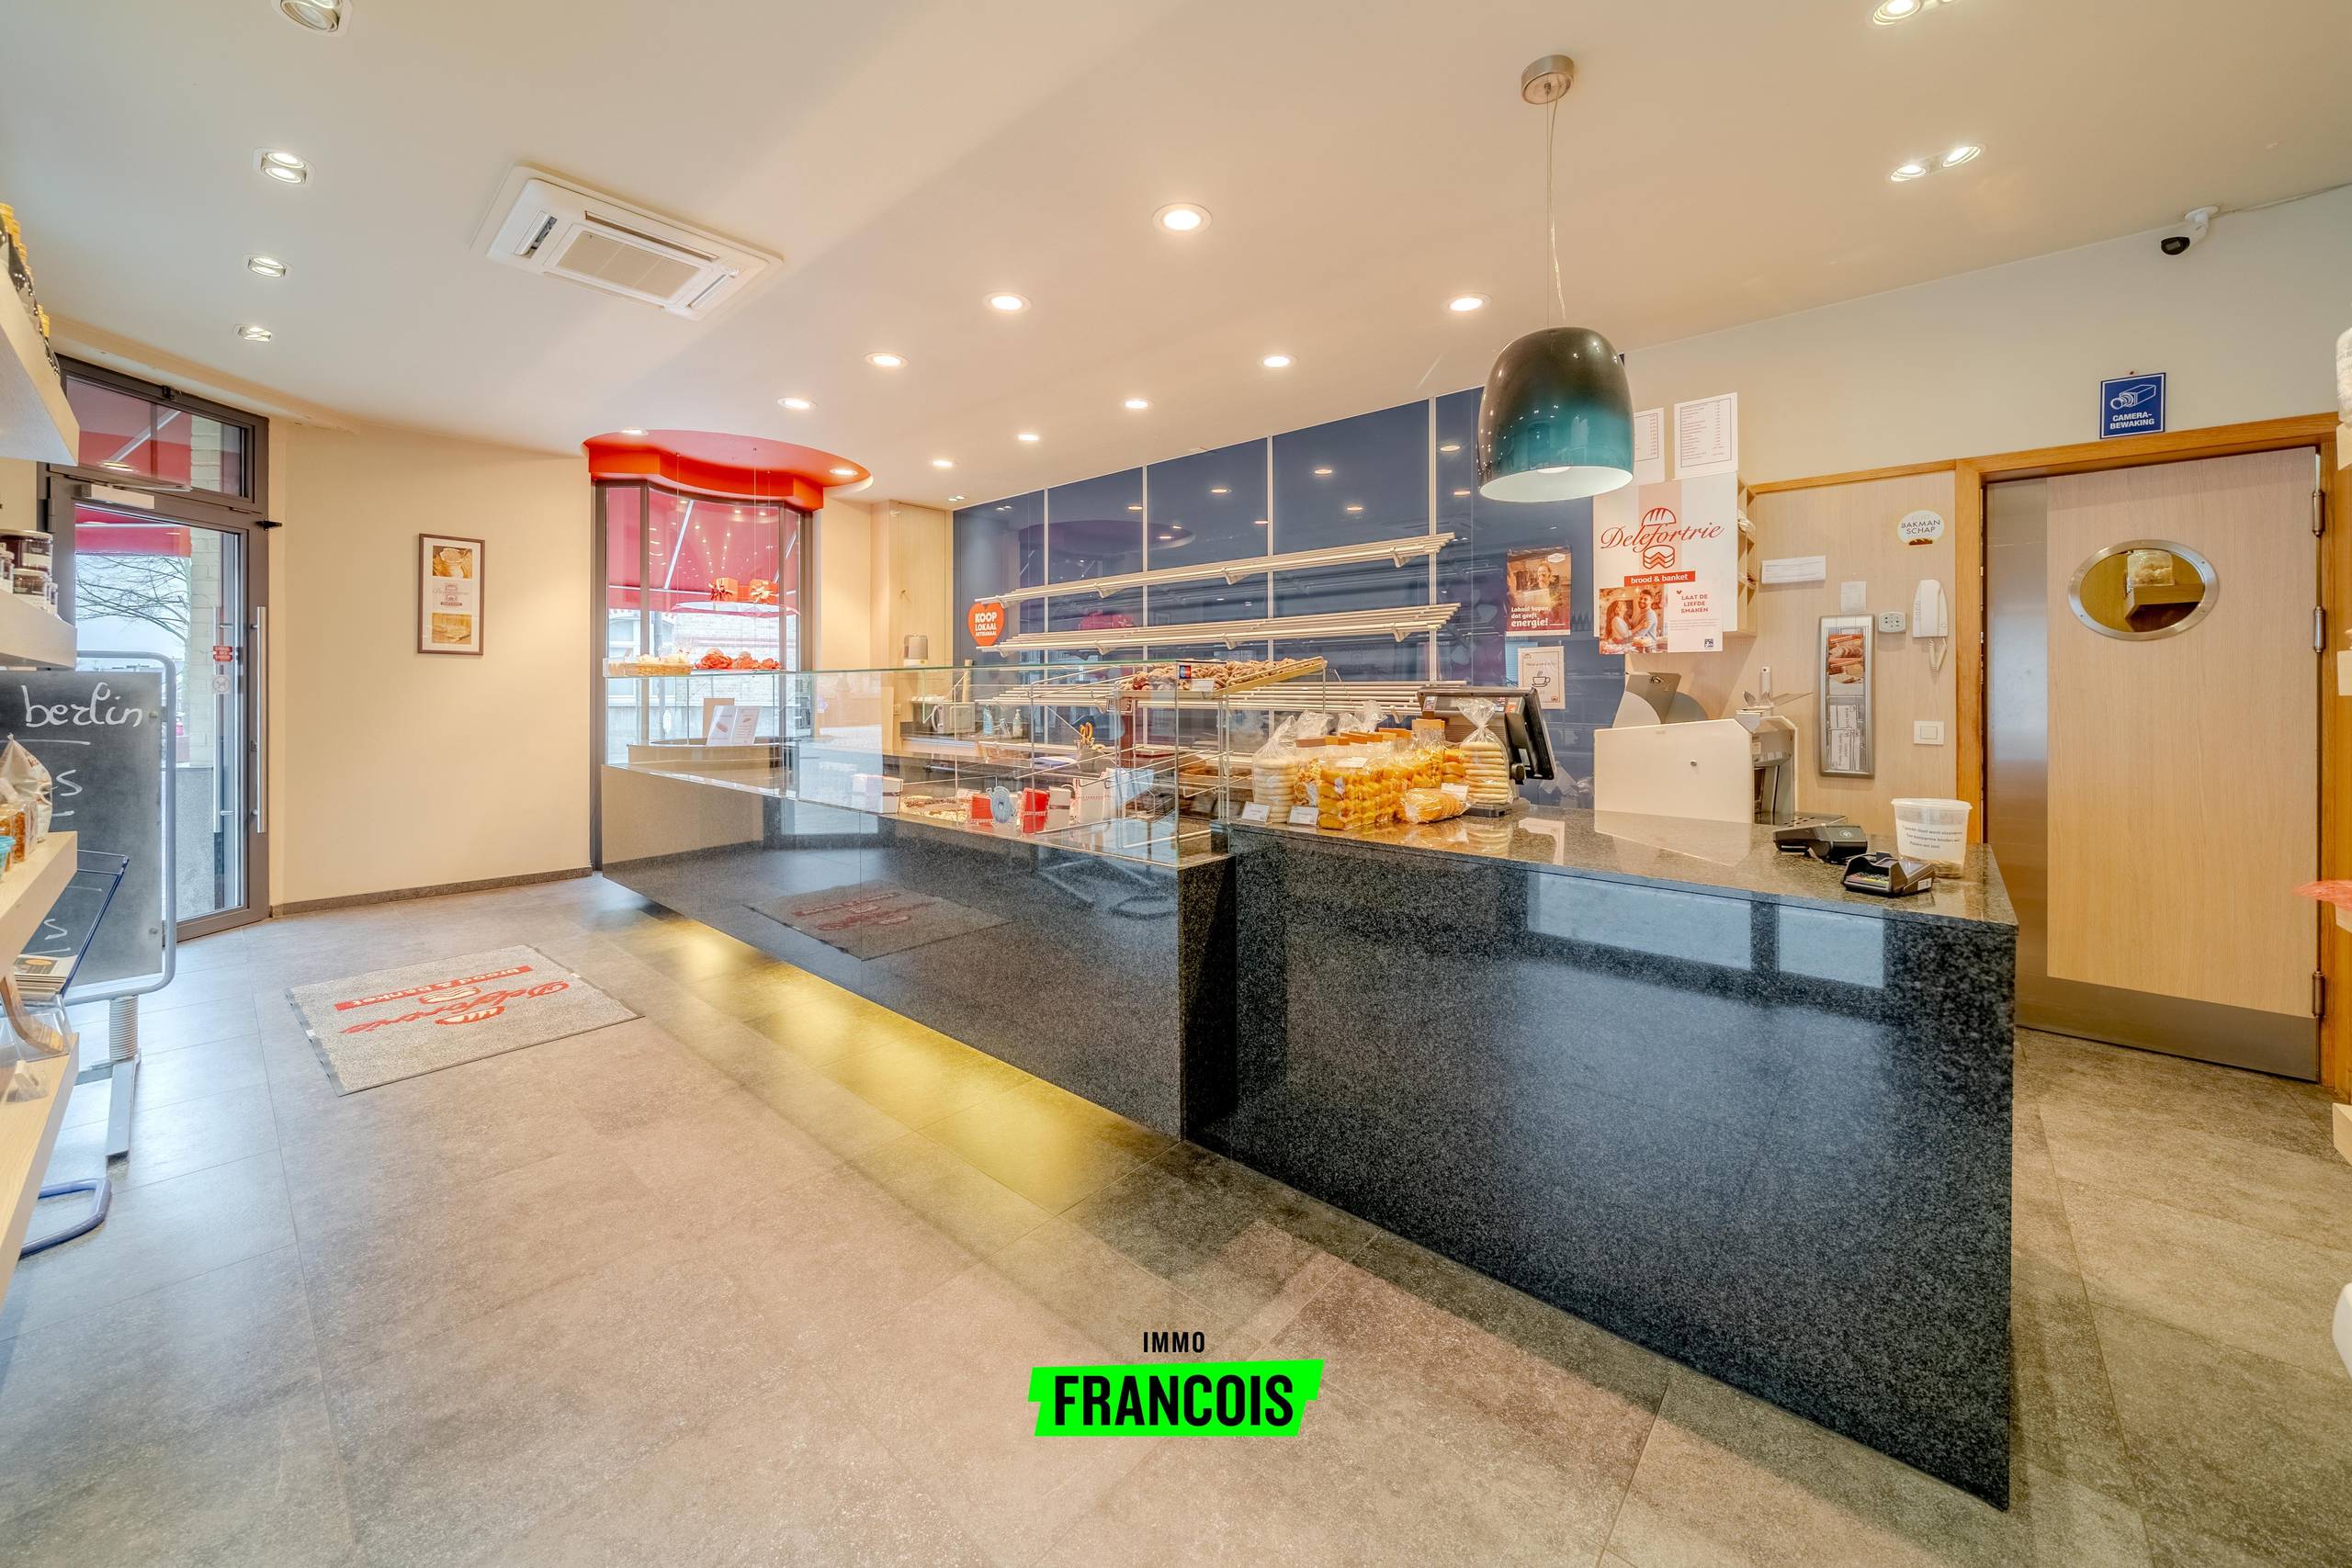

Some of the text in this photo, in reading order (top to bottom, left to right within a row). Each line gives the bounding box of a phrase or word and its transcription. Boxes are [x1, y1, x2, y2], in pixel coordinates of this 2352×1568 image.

[2112, 412, 2153, 422] CAMERA-
[2109, 418, 2154, 430] BEWAKING
[1600, 522, 1724, 553] Delefortrie
[1631, 576, 1653, 584] brood
[1661, 573, 1689, 581] banket
[975, 612, 997, 624] KOOP
[1510, 618, 1549, 628] energie!
[975, 623, 997, 631] LOKAAL
[21, 682, 143, 728] berlin
